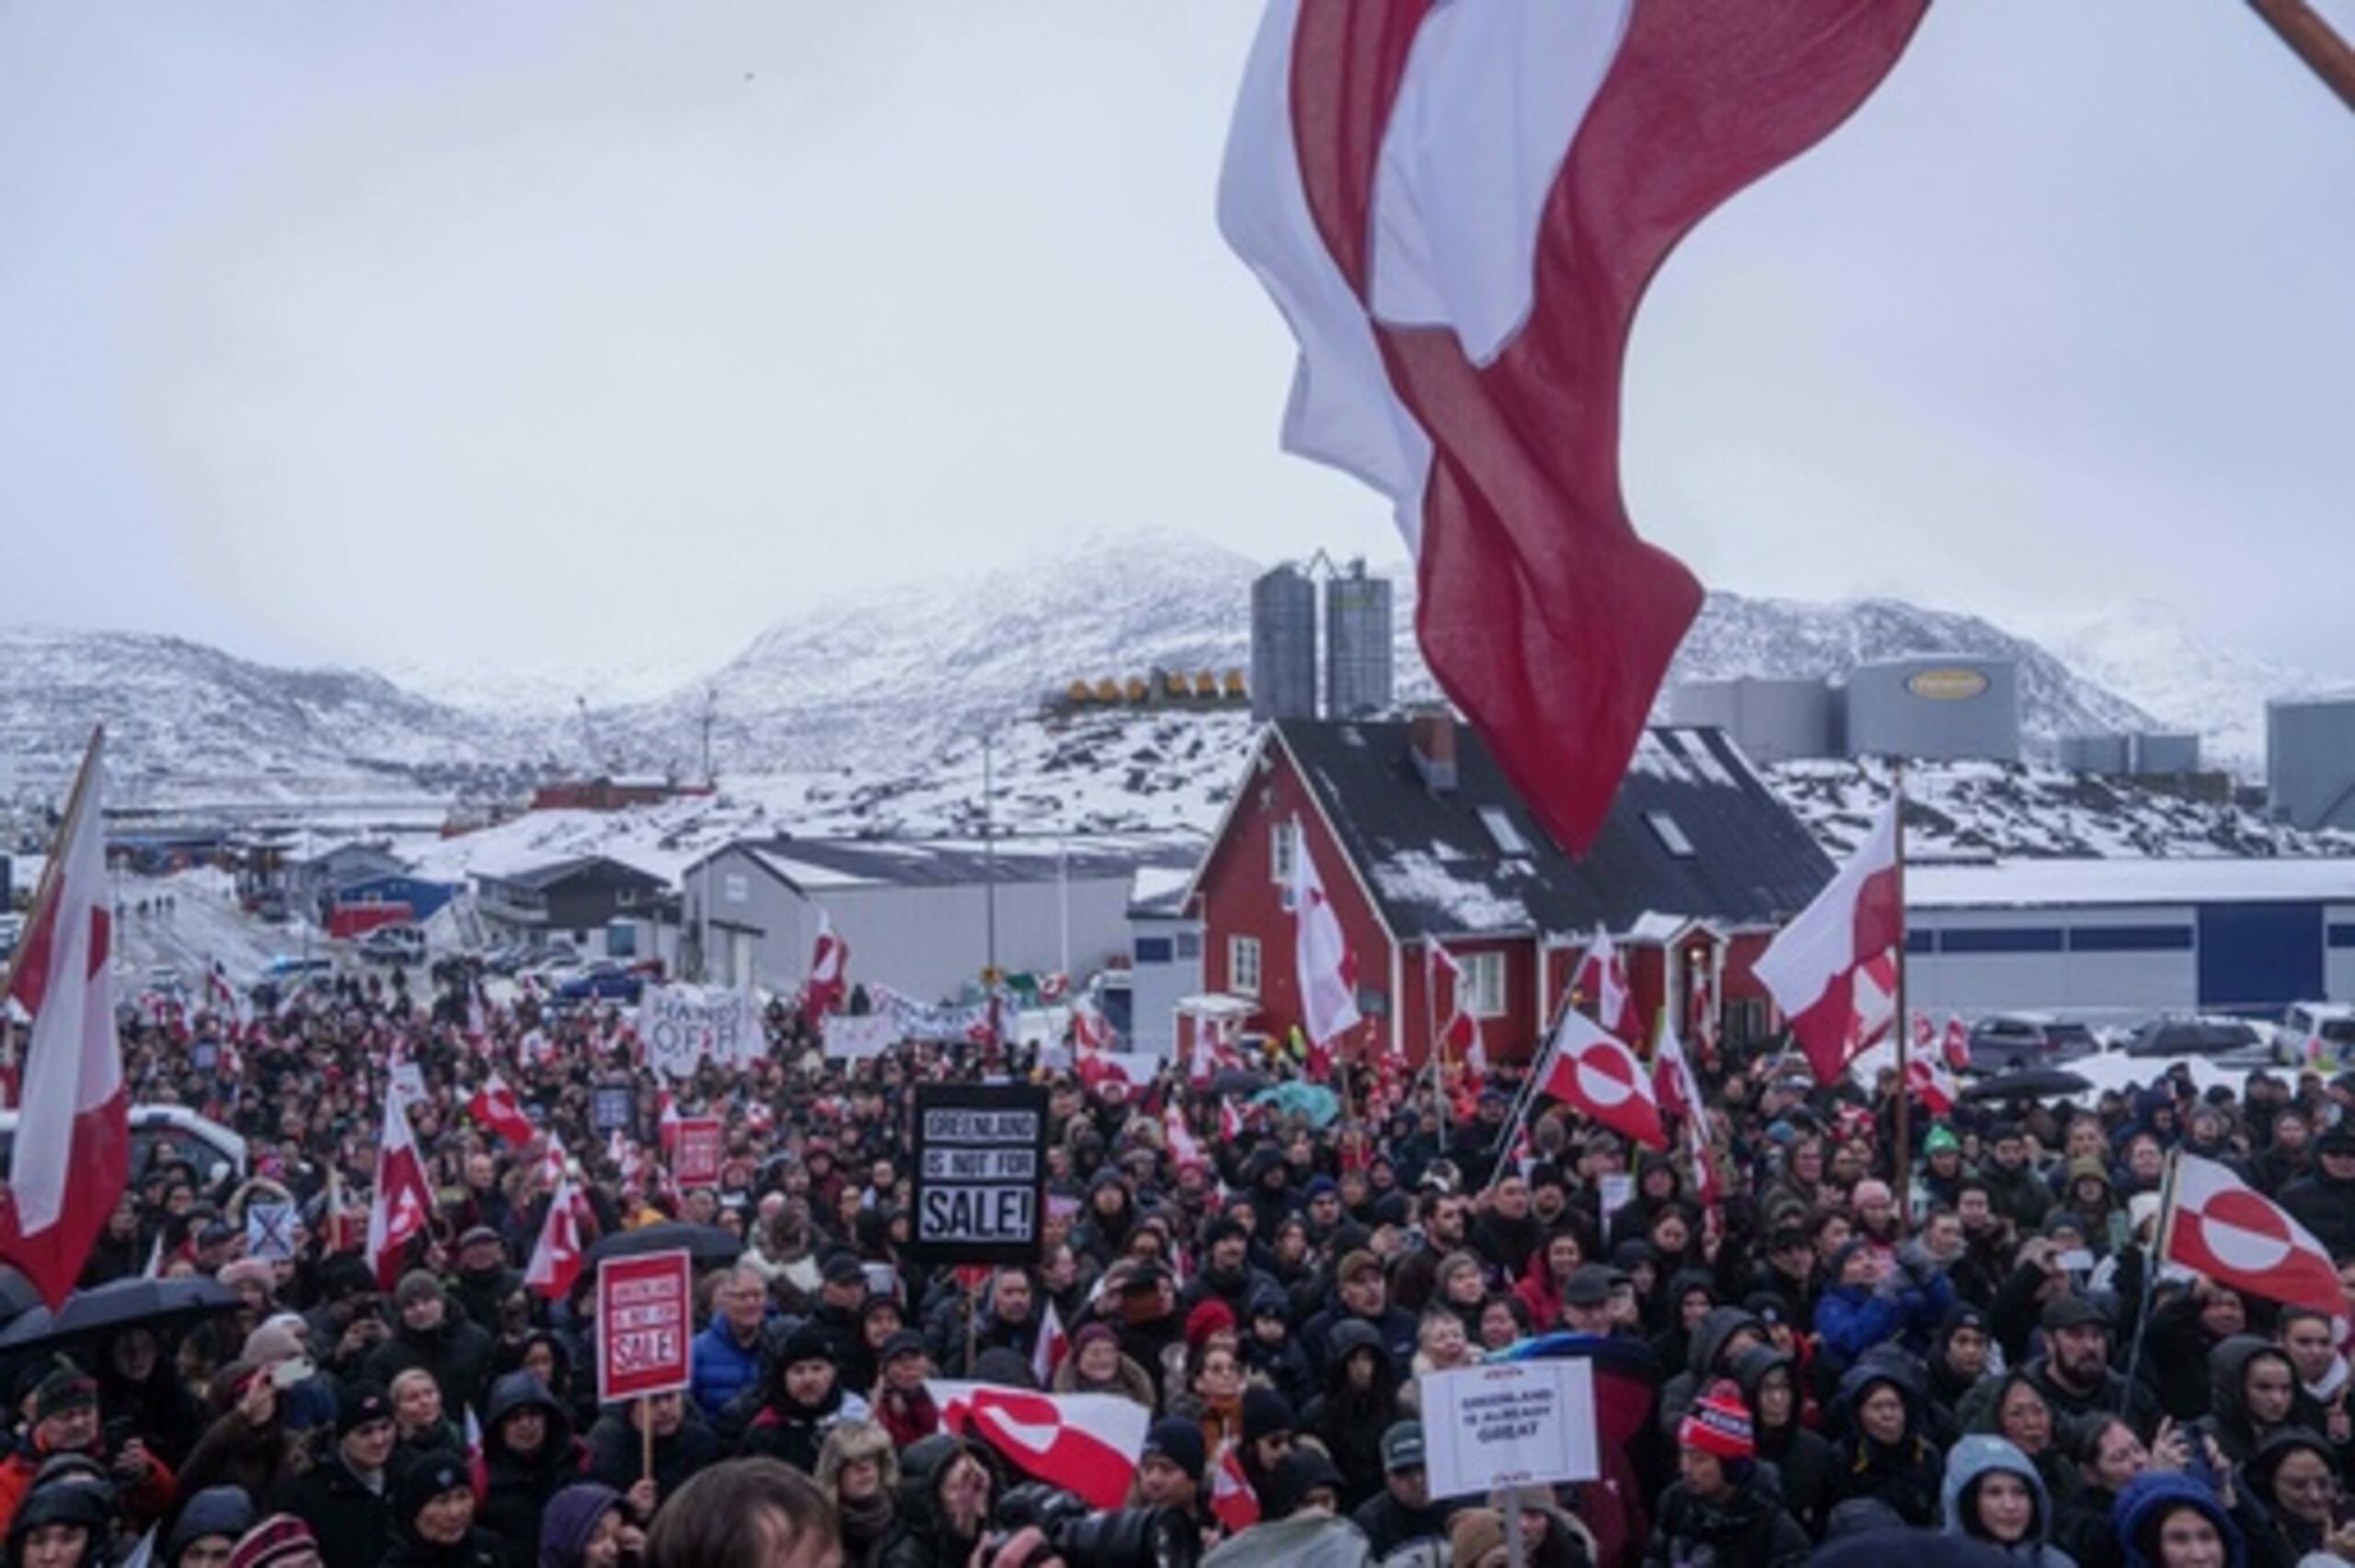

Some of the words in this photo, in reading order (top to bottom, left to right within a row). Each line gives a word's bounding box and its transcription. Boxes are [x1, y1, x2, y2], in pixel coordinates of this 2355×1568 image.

[927, 1153, 944, 1173] IS
[951, 1153, 988, 1173] NOT
[998, 1153, 1031, 1173] FOR
[925, 1189, 1028, 1237] SALE!
